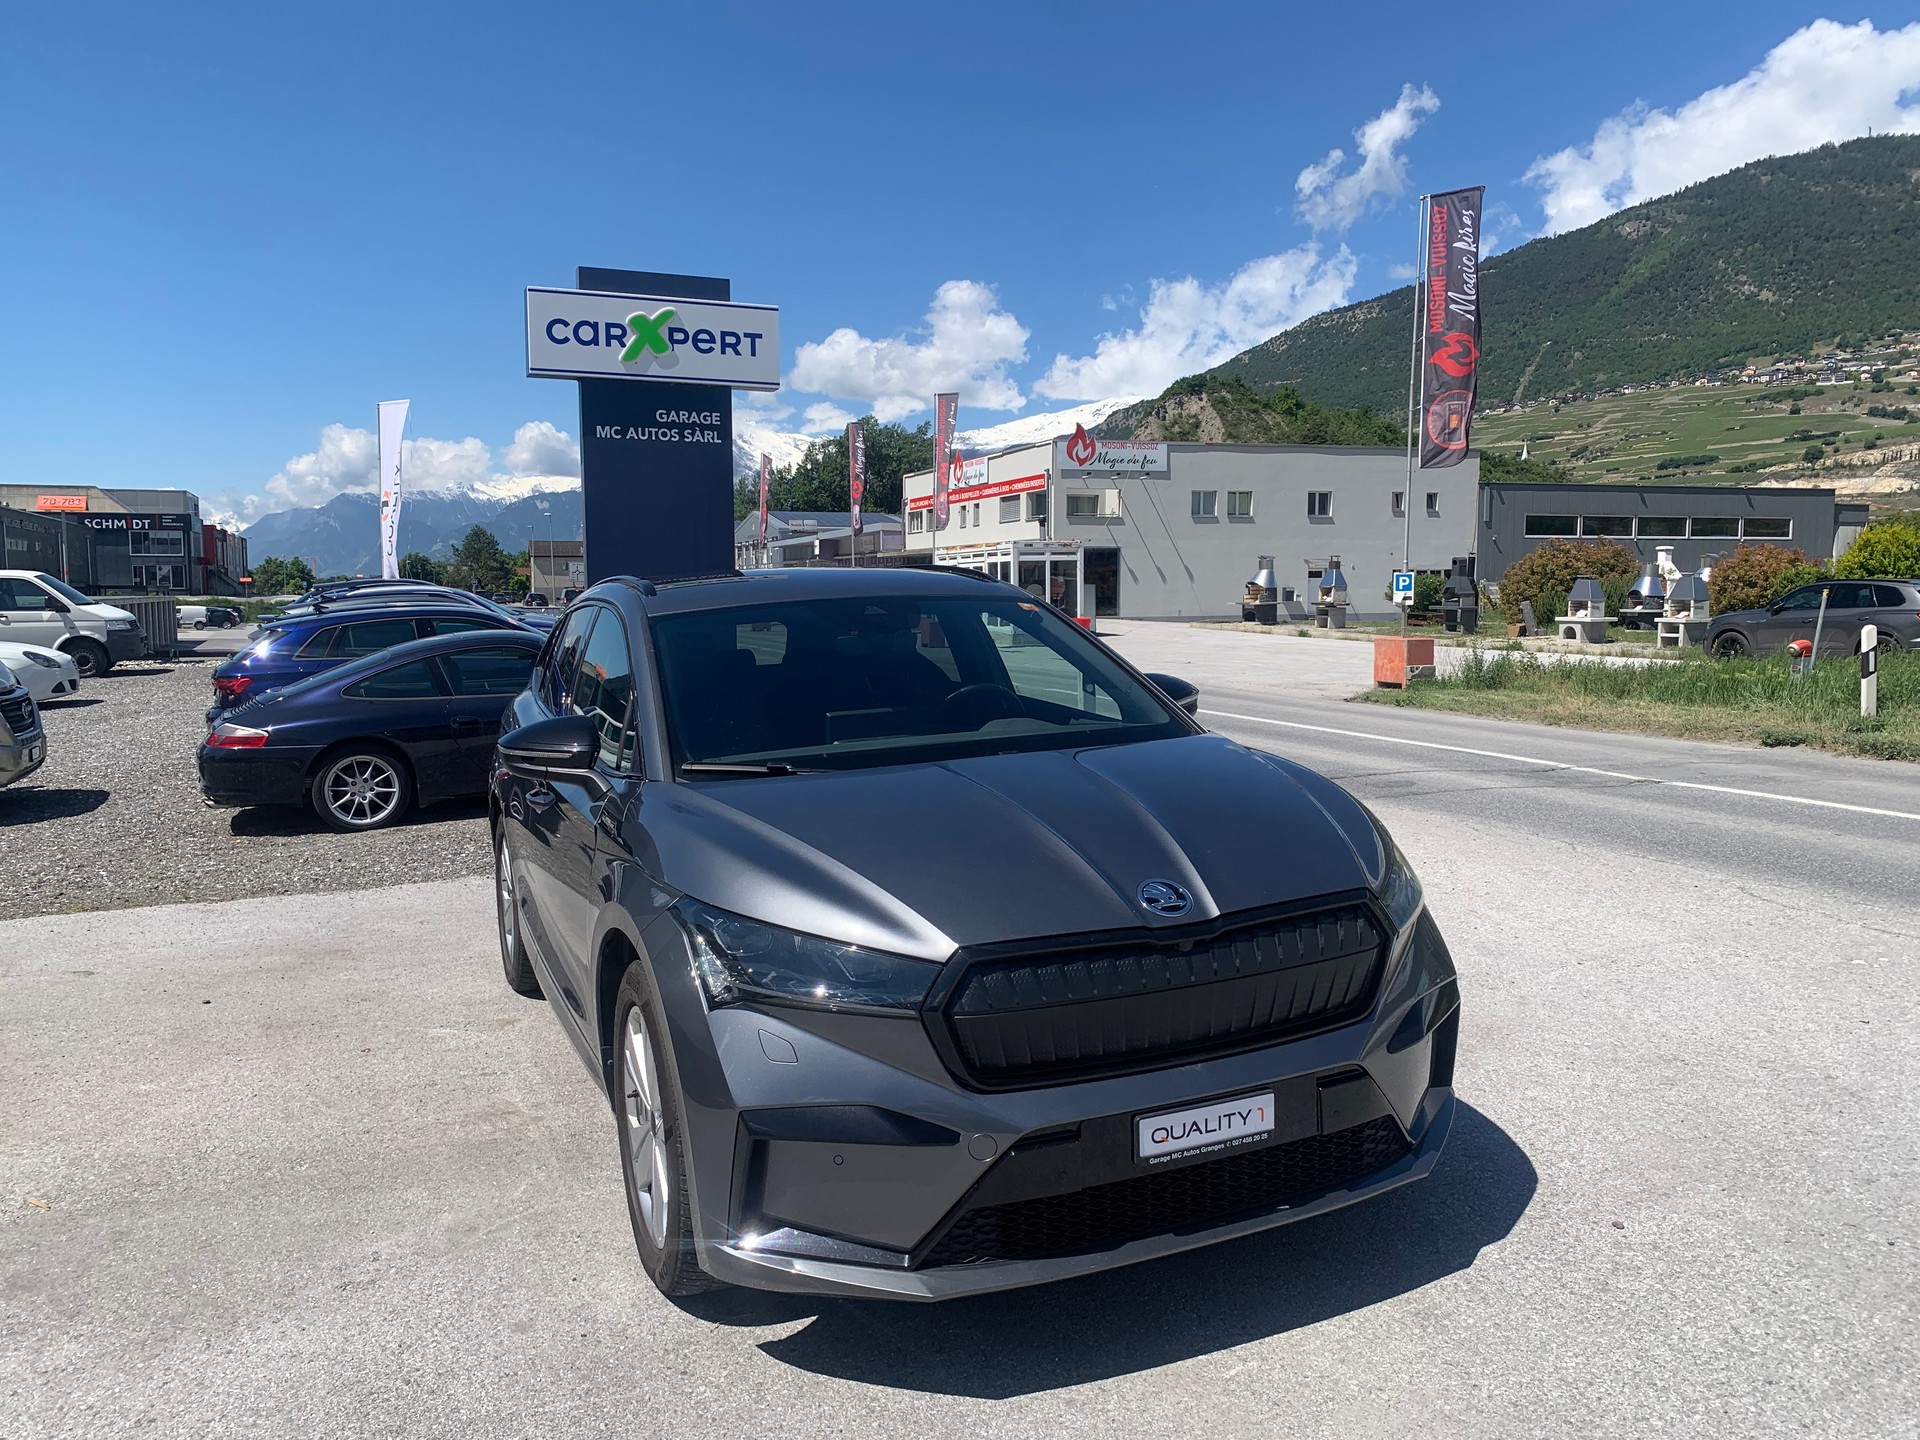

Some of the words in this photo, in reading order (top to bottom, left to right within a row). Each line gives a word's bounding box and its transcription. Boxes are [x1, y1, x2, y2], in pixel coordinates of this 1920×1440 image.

[1452, 209, 1477, 253] fires
[1430, 203, 1448, 333] MOSONI-VUISSOZ
[1447, 254, 1477, 322] Magic
[655, 409, 721, 425] GARAGE
[596, 426, 622, 439] MC
[626, 427, 680, 442] AUTOS
[684, 427, 722, 443] SÀRL
[1101, 441, 1159, 451] MOSONI-VUISSOZ
[1089, 451, 1125, 469] Magie
[1126, 454, 1140, 465] du
[1140, 454, 1158, 470] feu
[43, 498, 82, 506] 70-783
[1399, 576, 1410, 590] P
[1151, 1108, 1253, 1144] QUALITY
[1257, 1107, 1265, 1122] 1
[1149, 1154, 1171, 1164] Garage
[1171, 1151, 1183, 1160] MC
[1183, 1149, 1200, 1157] Autos
[1200, 1144, 1225, 1153] Granges
